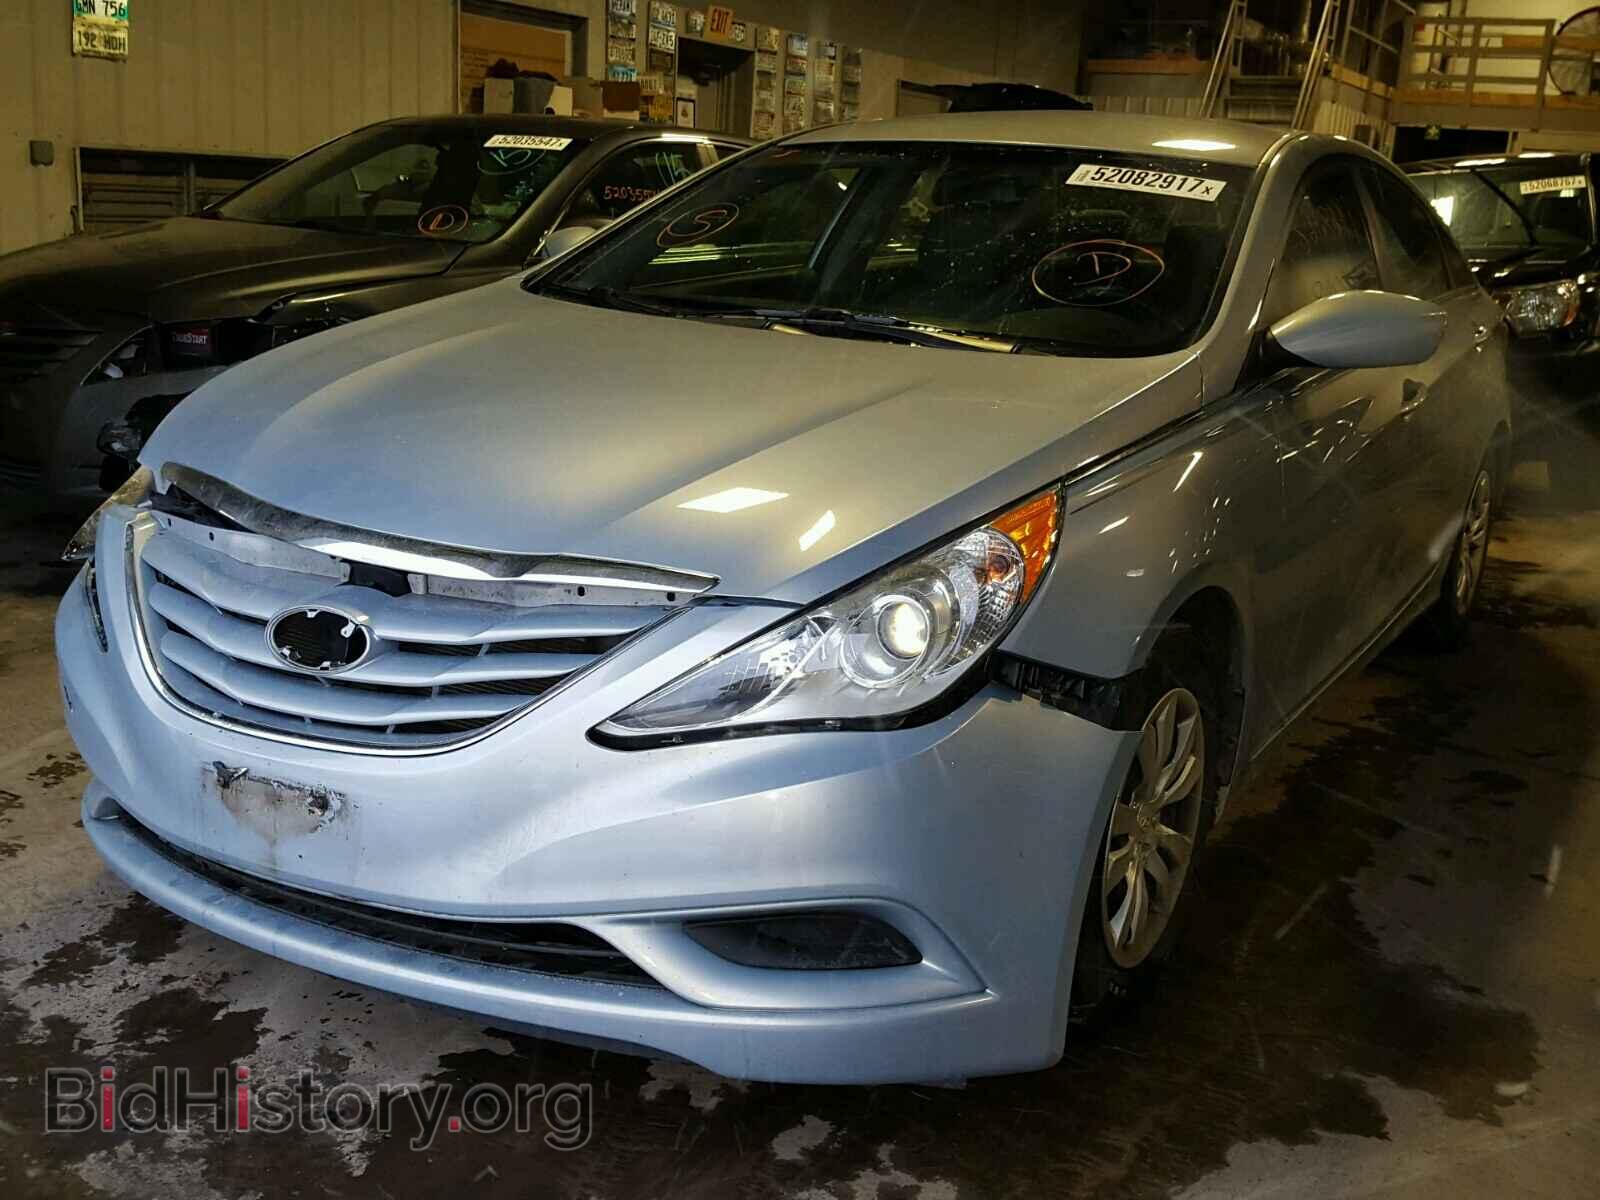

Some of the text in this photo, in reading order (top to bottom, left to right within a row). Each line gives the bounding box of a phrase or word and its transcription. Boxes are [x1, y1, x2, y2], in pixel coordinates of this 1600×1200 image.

[103, 0, 126, 17] 756
[711, 7, 730, 36] EXIT
[78, 30, 97, 48] 192
